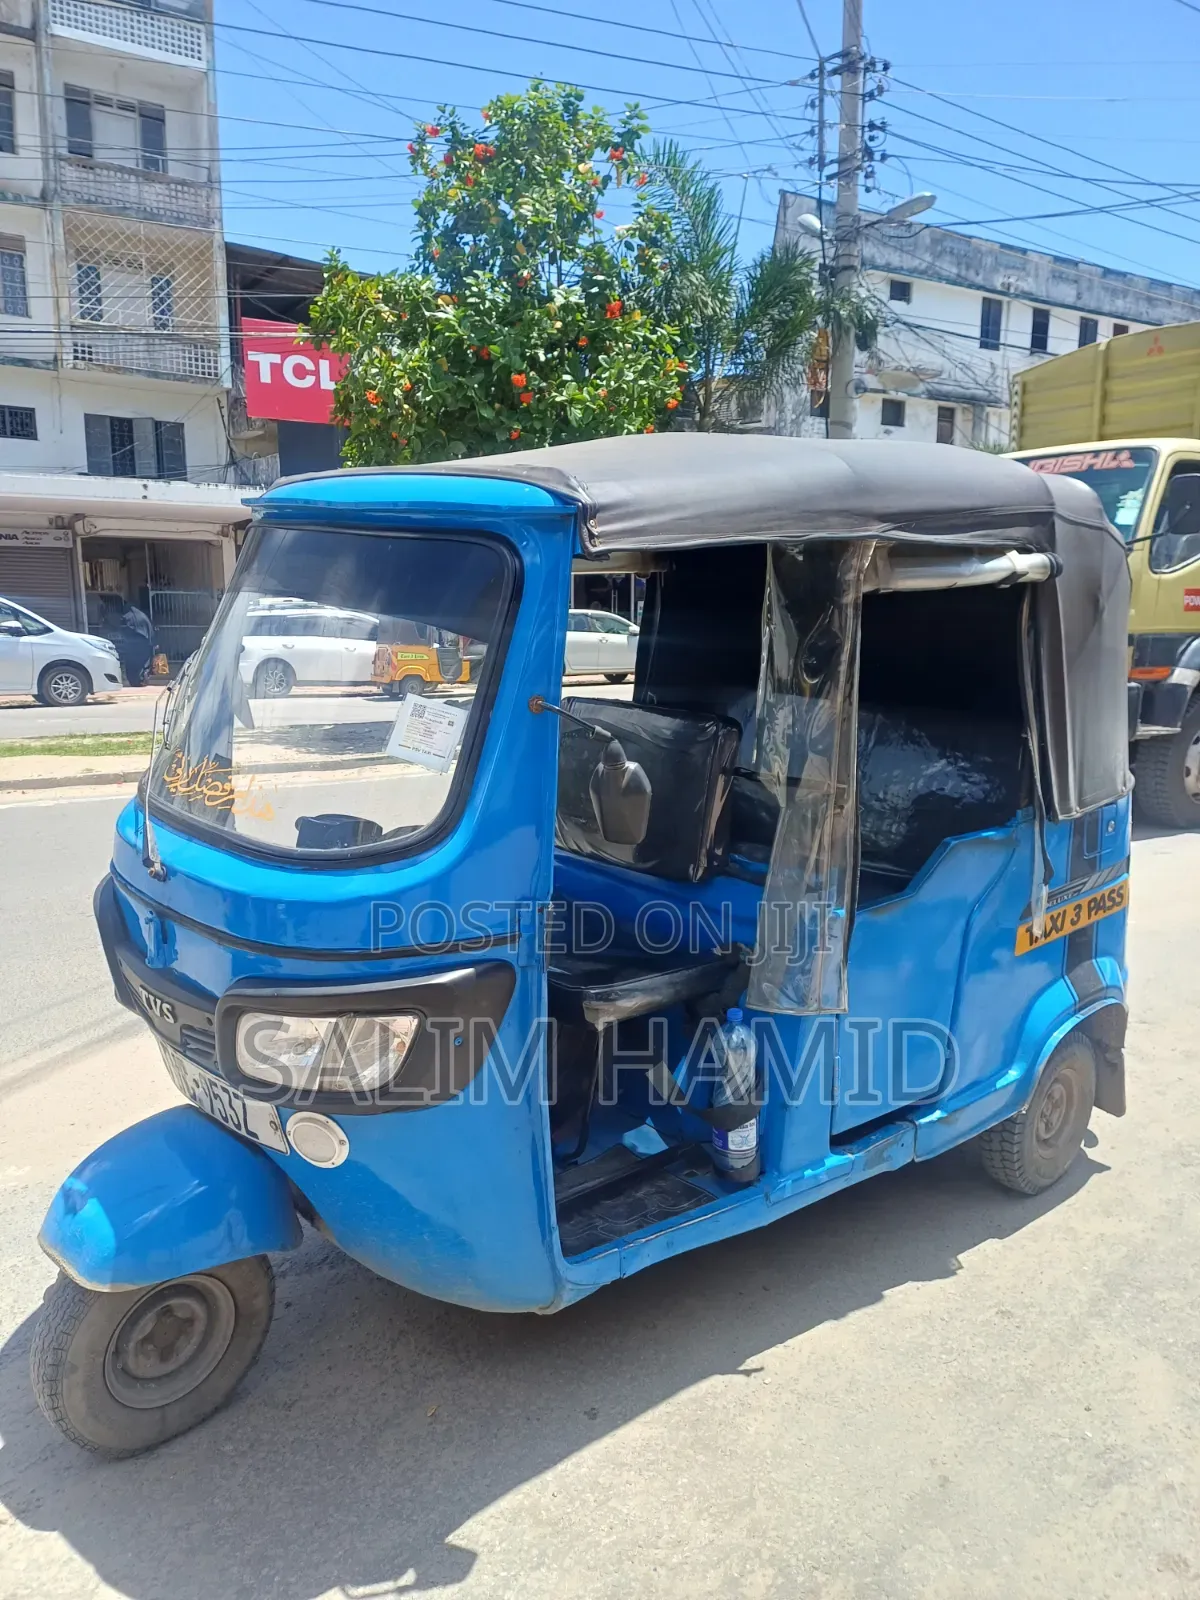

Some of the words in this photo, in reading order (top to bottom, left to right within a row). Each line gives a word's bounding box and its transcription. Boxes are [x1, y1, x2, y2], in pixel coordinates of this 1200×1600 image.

[247, 351, 337, 390] TCL
[1070, 903, 1083, 927] 3
[1087, 885, 1125, 920] PASS
[138, 985, 176, 1025] TVS
